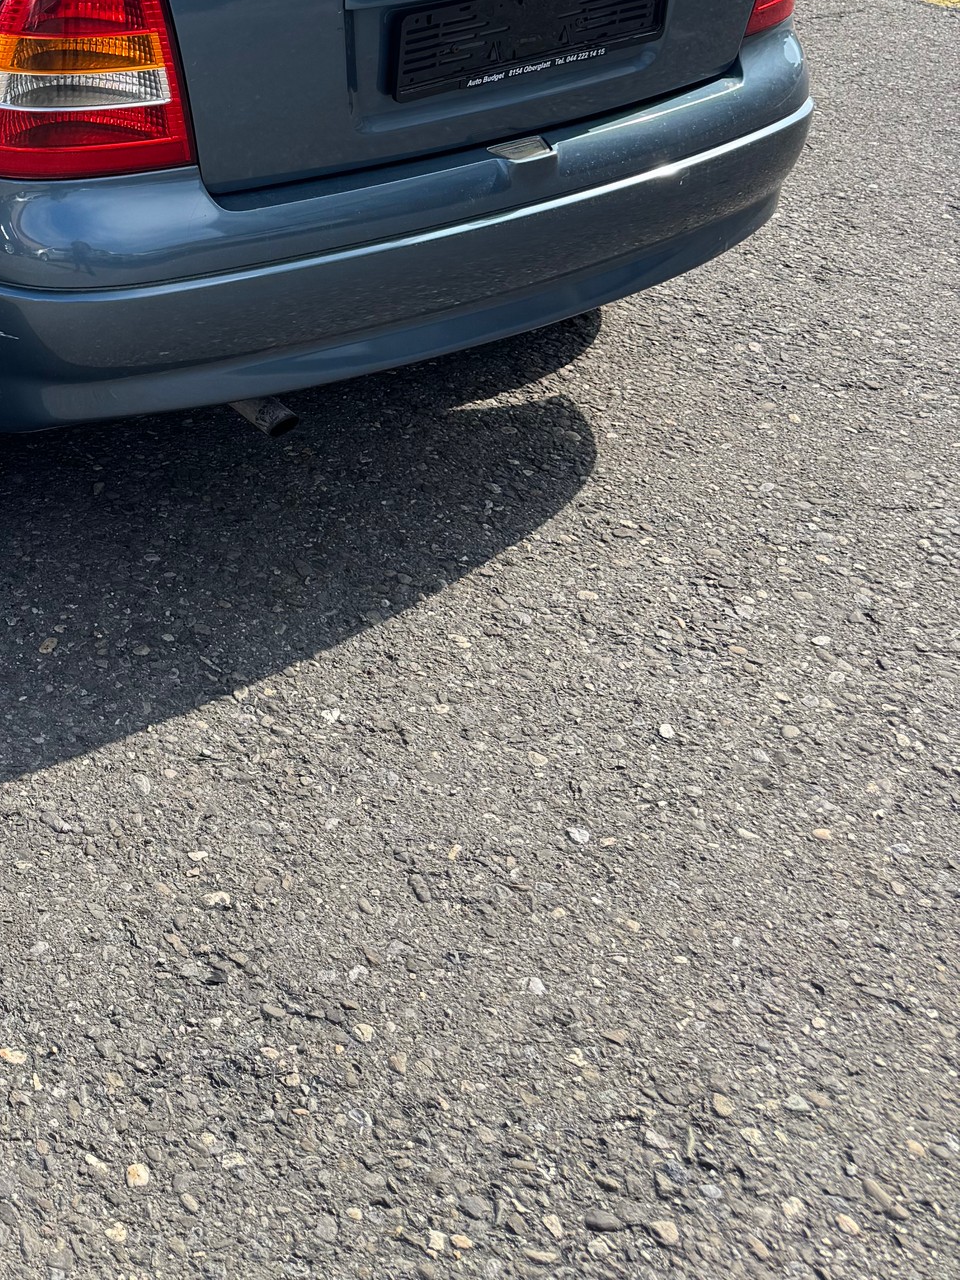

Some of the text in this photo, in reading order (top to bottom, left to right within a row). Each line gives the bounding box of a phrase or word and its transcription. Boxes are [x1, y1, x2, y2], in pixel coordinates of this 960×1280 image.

[467, 78, 482, 87] Auto
[483, 72, 505, 84] Budget
[508, 68, 523, 77] 8154
[524, 61, 551, 73] Oberglatt
[555, 58, 566, 66] Tel.
[566, 55, 577, 63] 044
[577, 52, 589, 60] 222
[589, 50, 597, 58] 14
